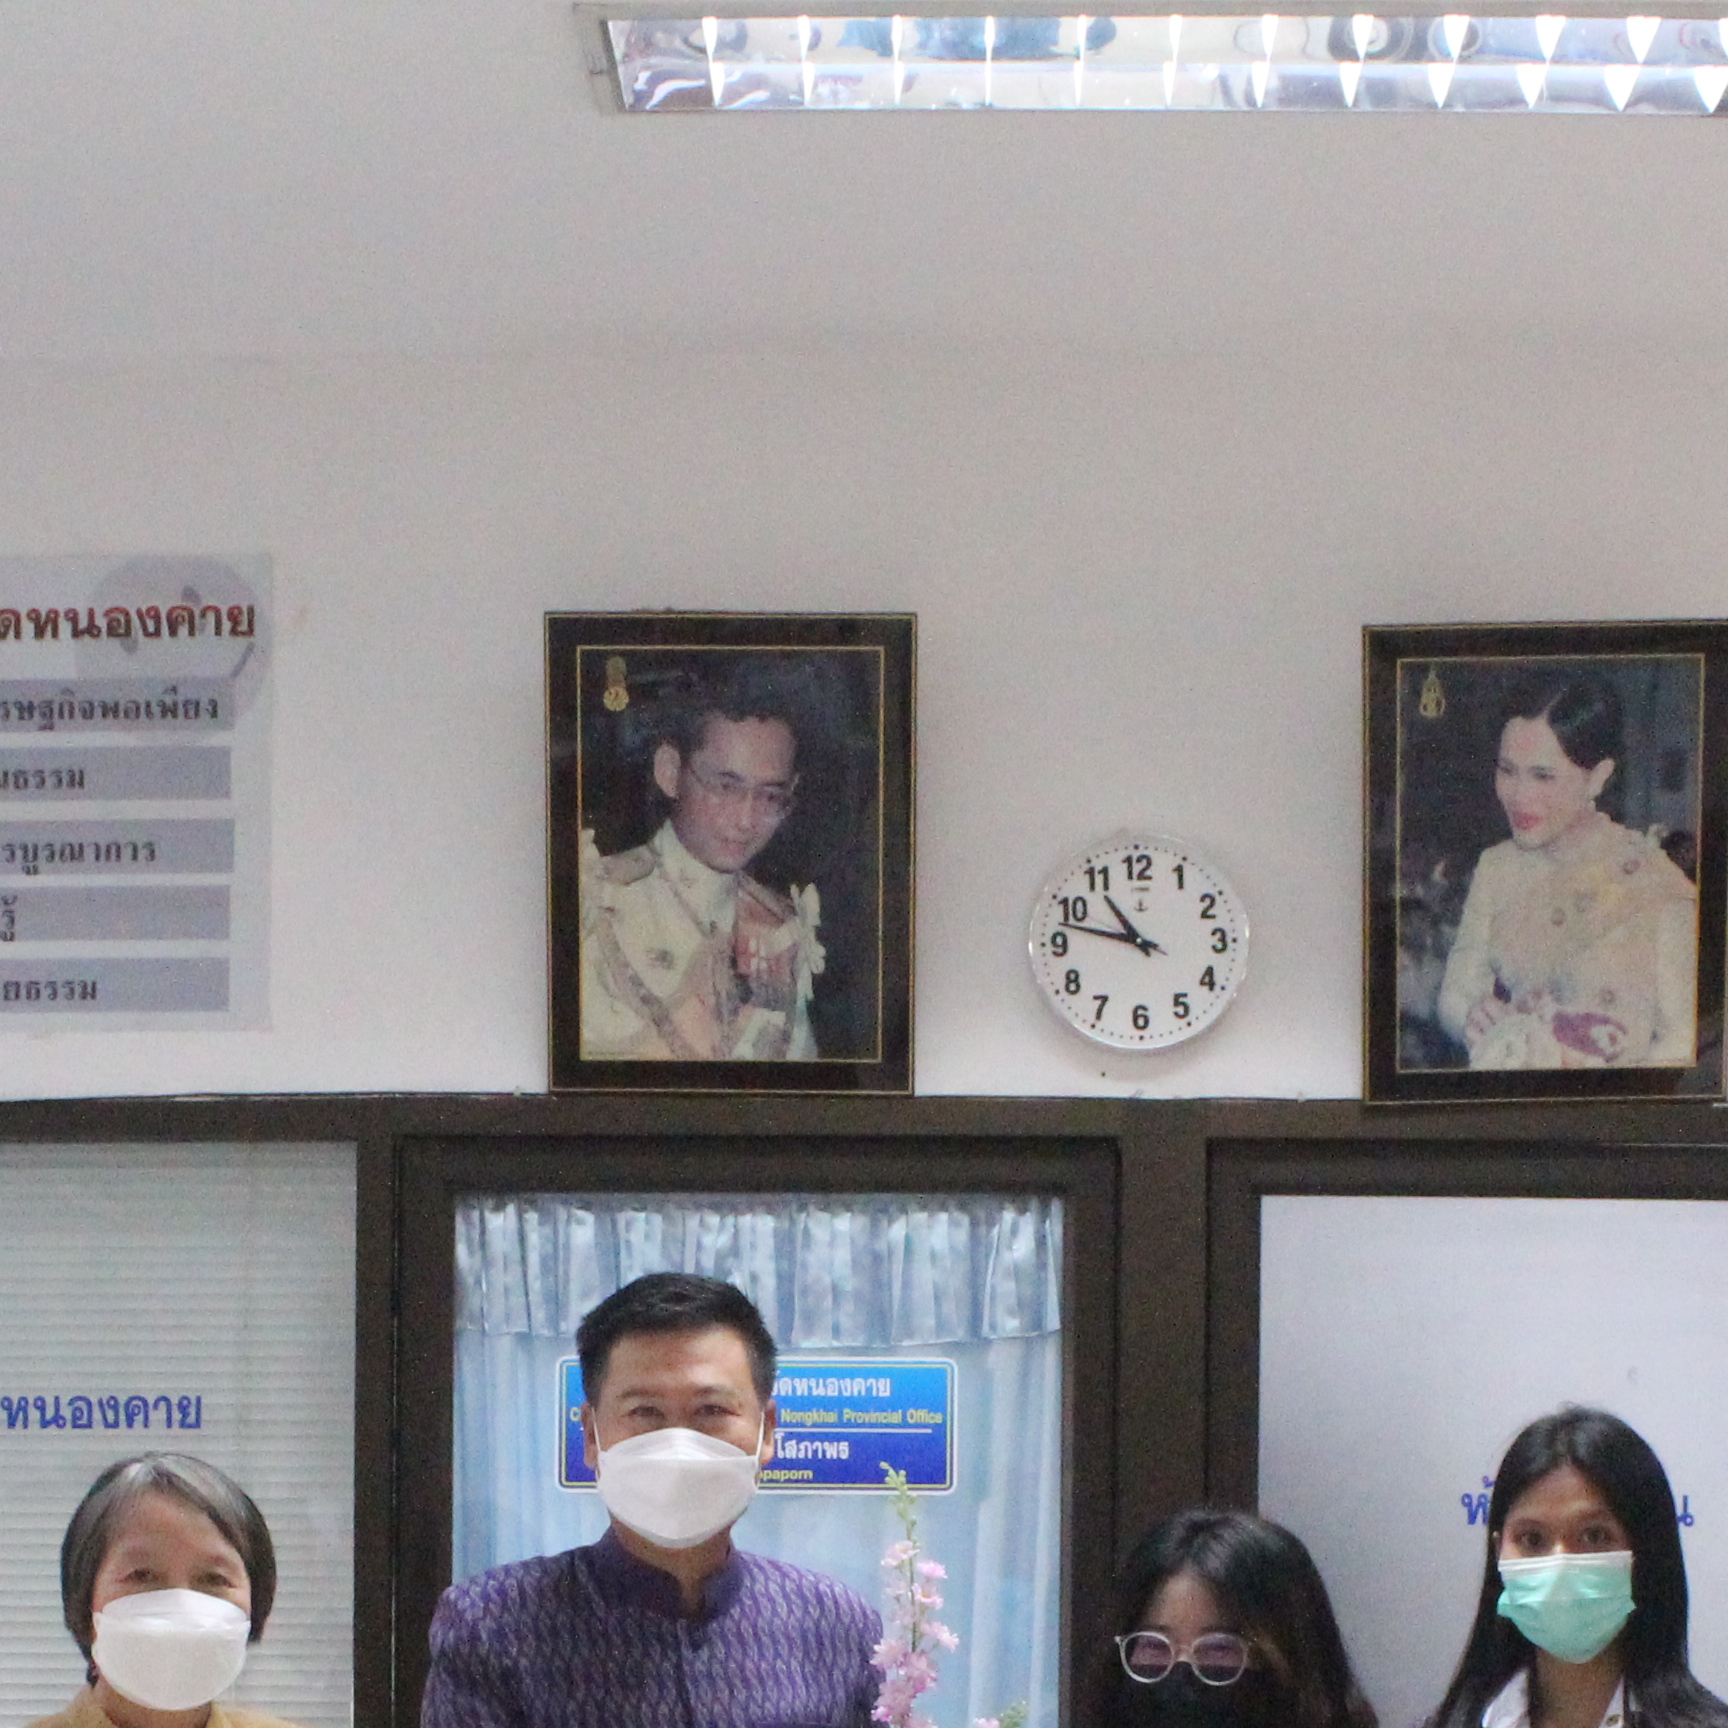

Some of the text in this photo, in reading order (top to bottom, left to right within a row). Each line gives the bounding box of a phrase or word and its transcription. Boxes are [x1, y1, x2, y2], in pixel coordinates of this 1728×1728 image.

[1084, 866, 1109, 892] 11
[1122, 854, 1152, 881] 12
[1173, 864, 1184, 889] 1
[1058, 896, 1087, 922] 10
[1200, 893, 1216, 919] 2
[1051, 931, 1068, 957] 9
[1211, 928, 1227, 953] 3
[1065, 969, 1080, 995] 8
[1200, 965, 1215, 991] 4
[1093, 995, 1109, 1021] 7
[1132, 1005, 1149, 1030] 6
[1173, 993, 1190, 1019] 5
[780, 1408, 943, 1426] Nongkhai Provincial Office
[774, 1432, 850, 1460] โสภาพร
